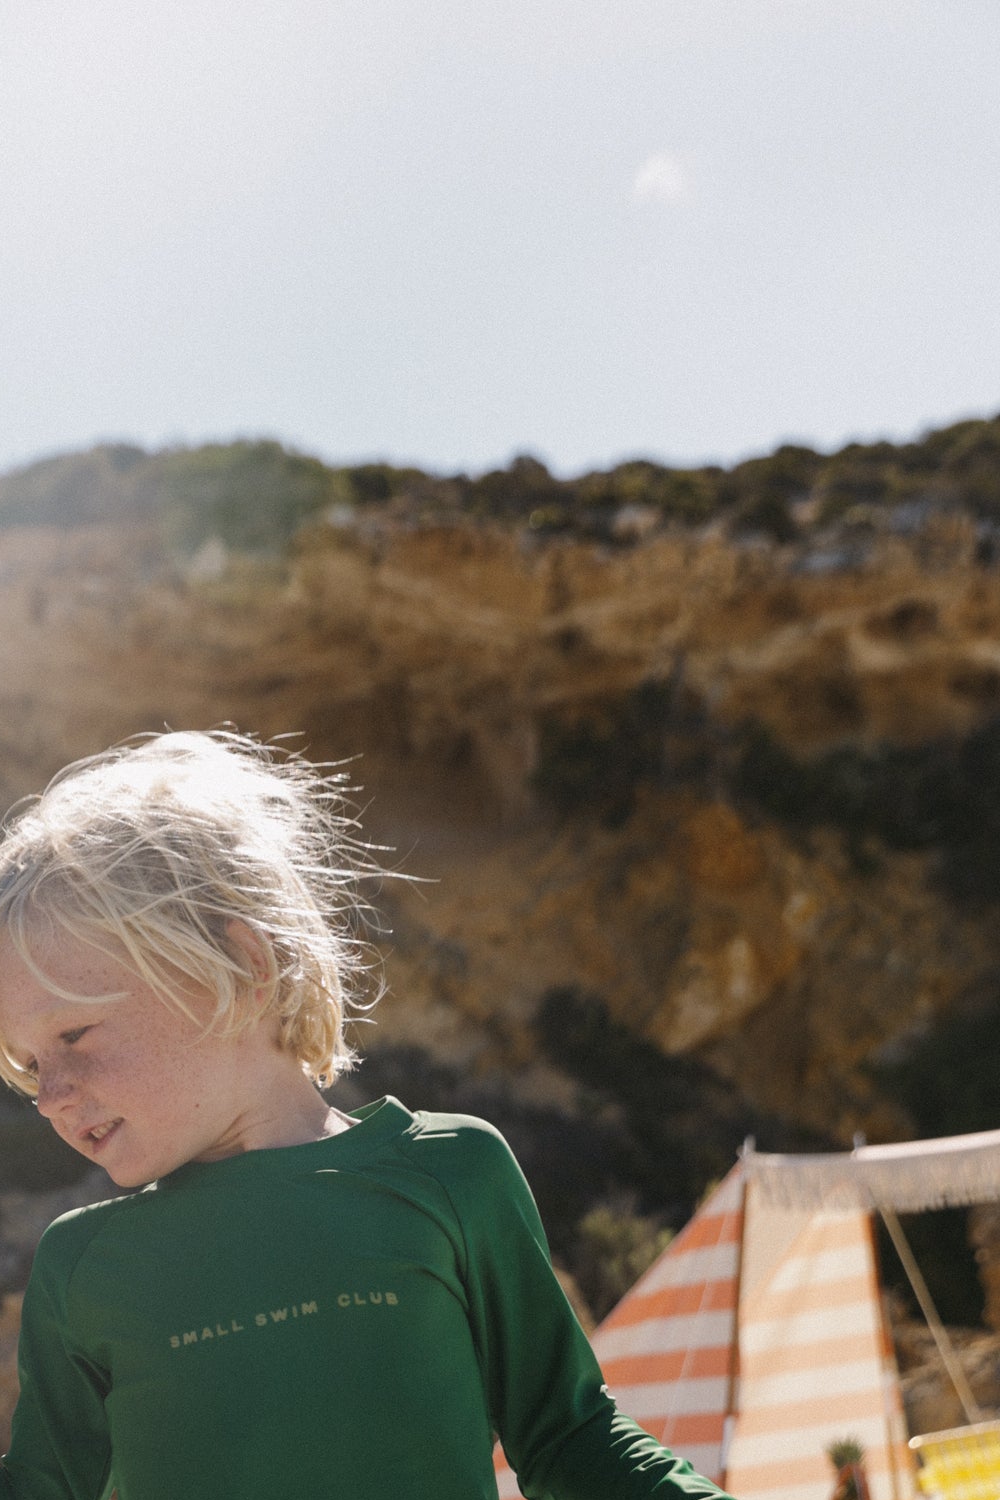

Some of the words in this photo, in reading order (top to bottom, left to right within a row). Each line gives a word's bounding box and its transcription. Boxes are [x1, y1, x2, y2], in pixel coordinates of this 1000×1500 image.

[169, 1318, 244, 1349] SMALL
[255, 1300, 319, 1327] SWIM
[337, 1291, 399, 1308] CLUB
